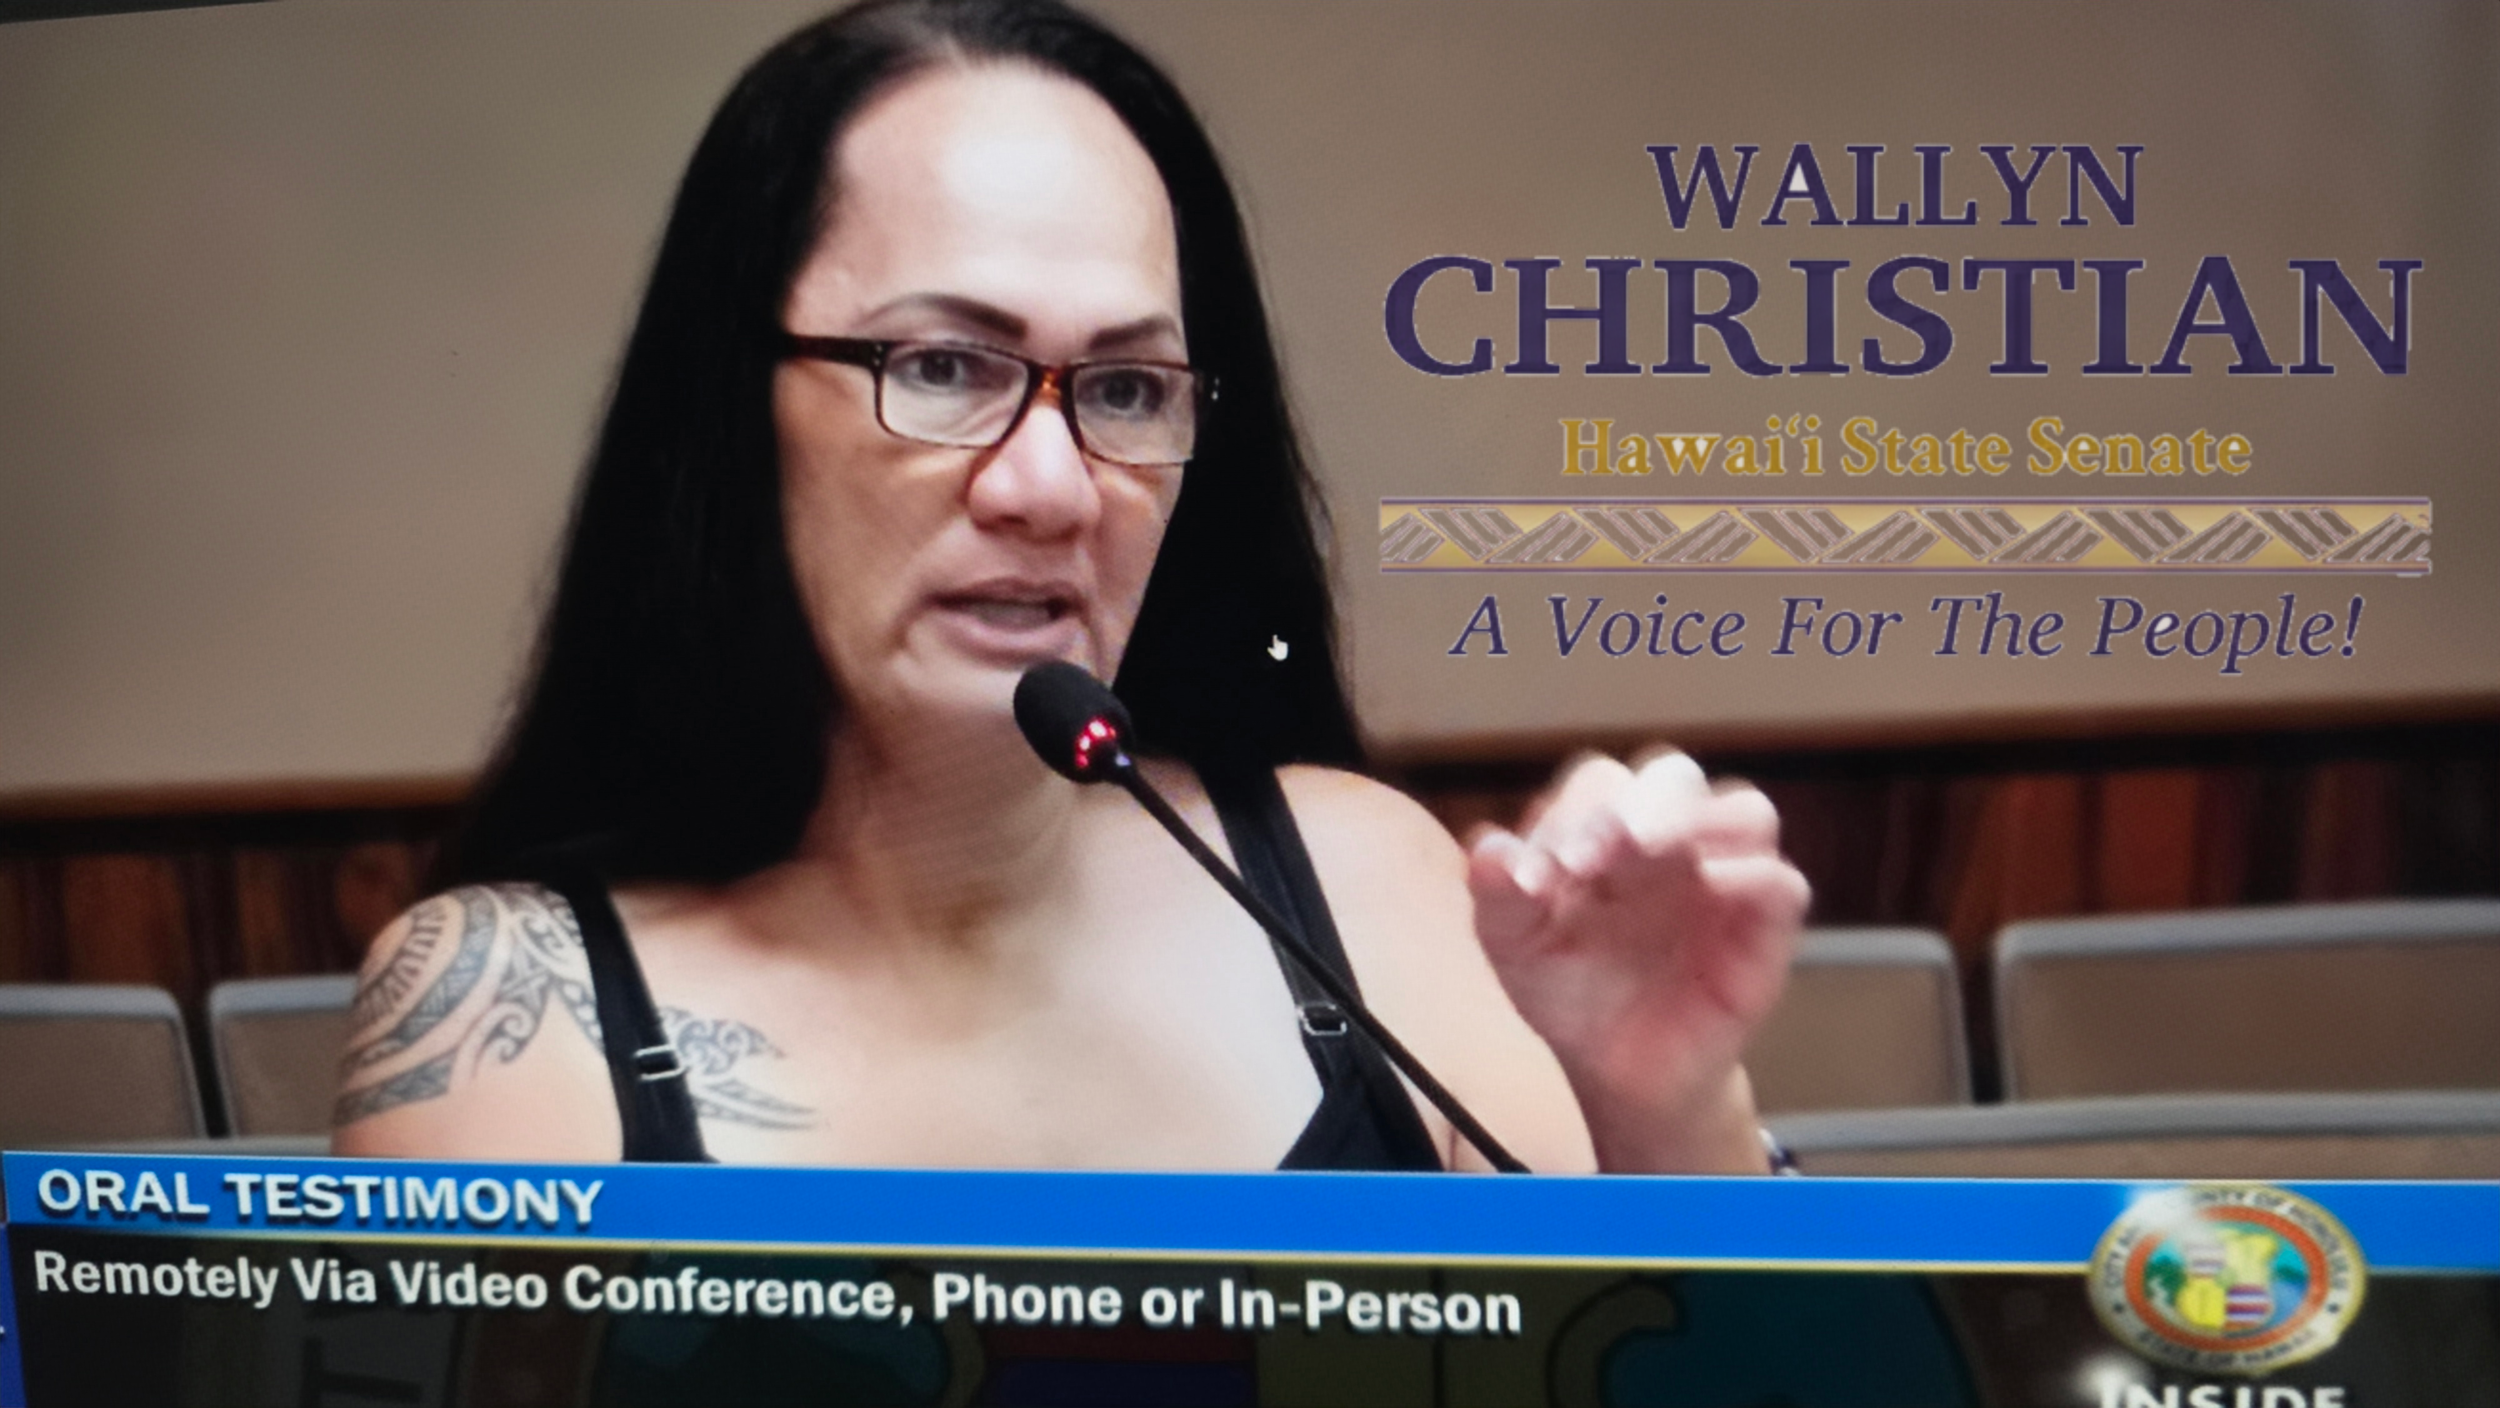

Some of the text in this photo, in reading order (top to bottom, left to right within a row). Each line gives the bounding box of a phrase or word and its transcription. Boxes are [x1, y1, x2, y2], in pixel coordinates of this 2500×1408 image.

[37, 1169, 604, 1226] ORAL TESTIMONY
[33, 1250, 1523, 1334] Remotely Via Video Conference, Phone or In-Person
